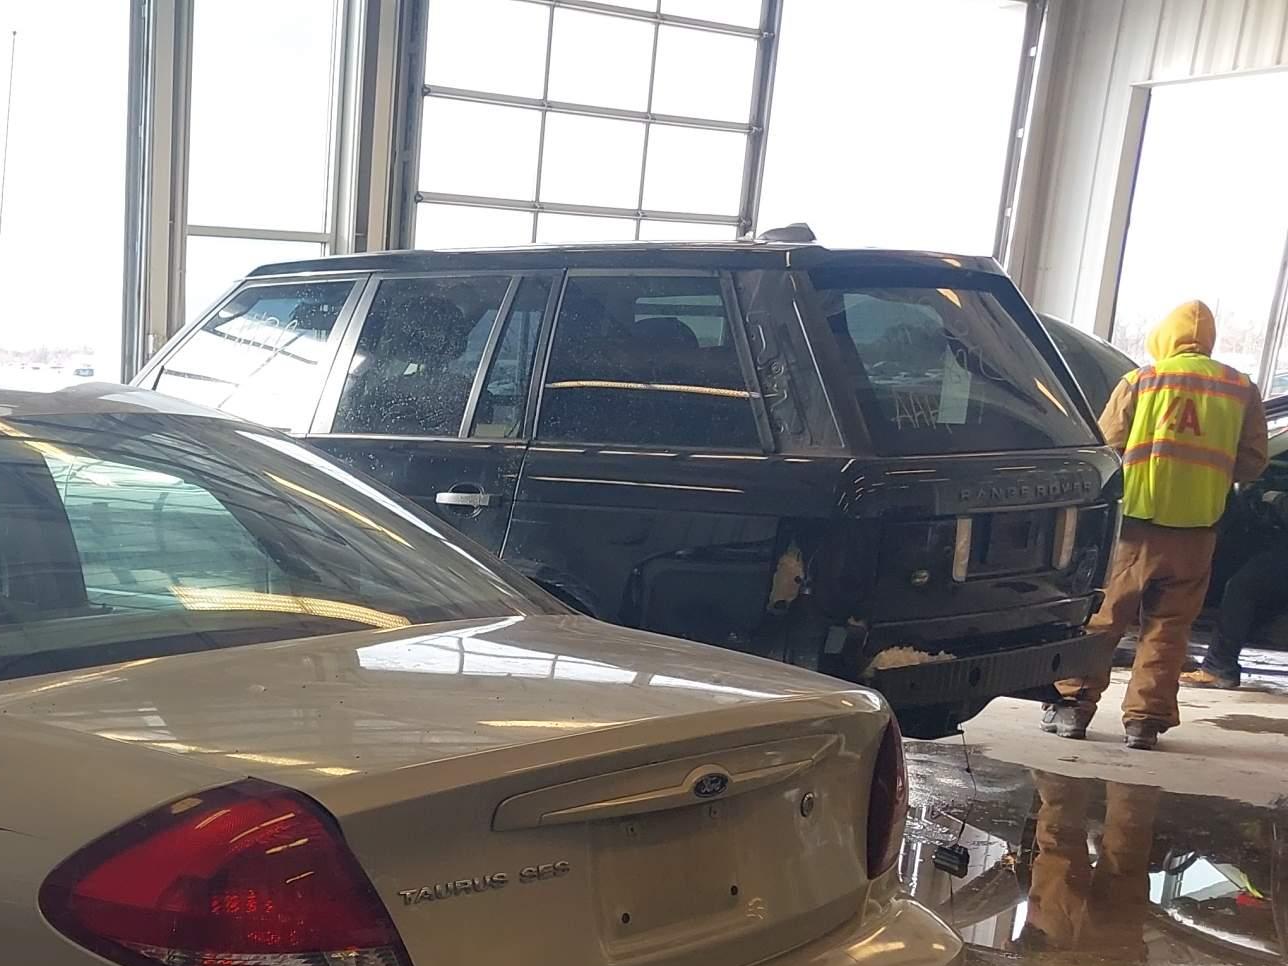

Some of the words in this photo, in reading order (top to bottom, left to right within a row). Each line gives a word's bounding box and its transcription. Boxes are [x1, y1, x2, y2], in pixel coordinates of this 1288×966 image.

[1036, 480, 1093, 498] ROVER
[398, 872, 508, 906] TAURUS
[518, 859, 571, 884] SES
